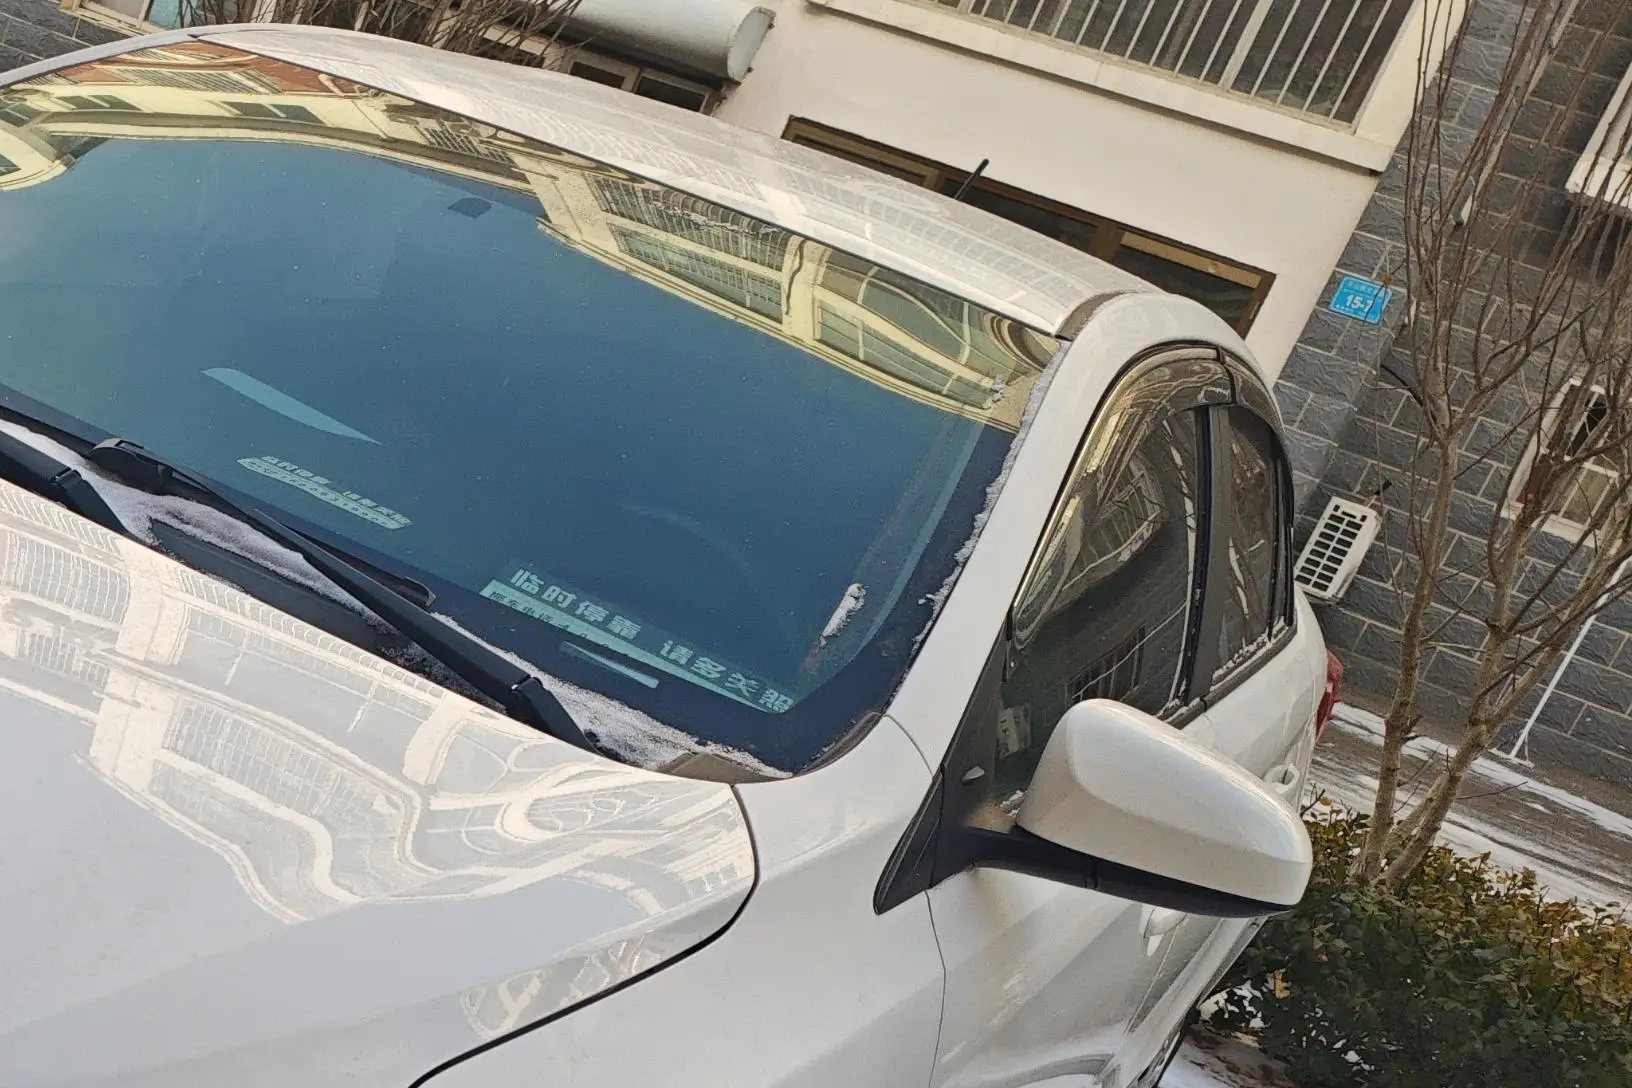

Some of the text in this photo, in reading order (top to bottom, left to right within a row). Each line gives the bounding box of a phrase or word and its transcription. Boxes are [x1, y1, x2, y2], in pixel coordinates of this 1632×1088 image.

[510, 568, 642, 640] 临时停靠
[660, 640, 795, 714] 请多关照
